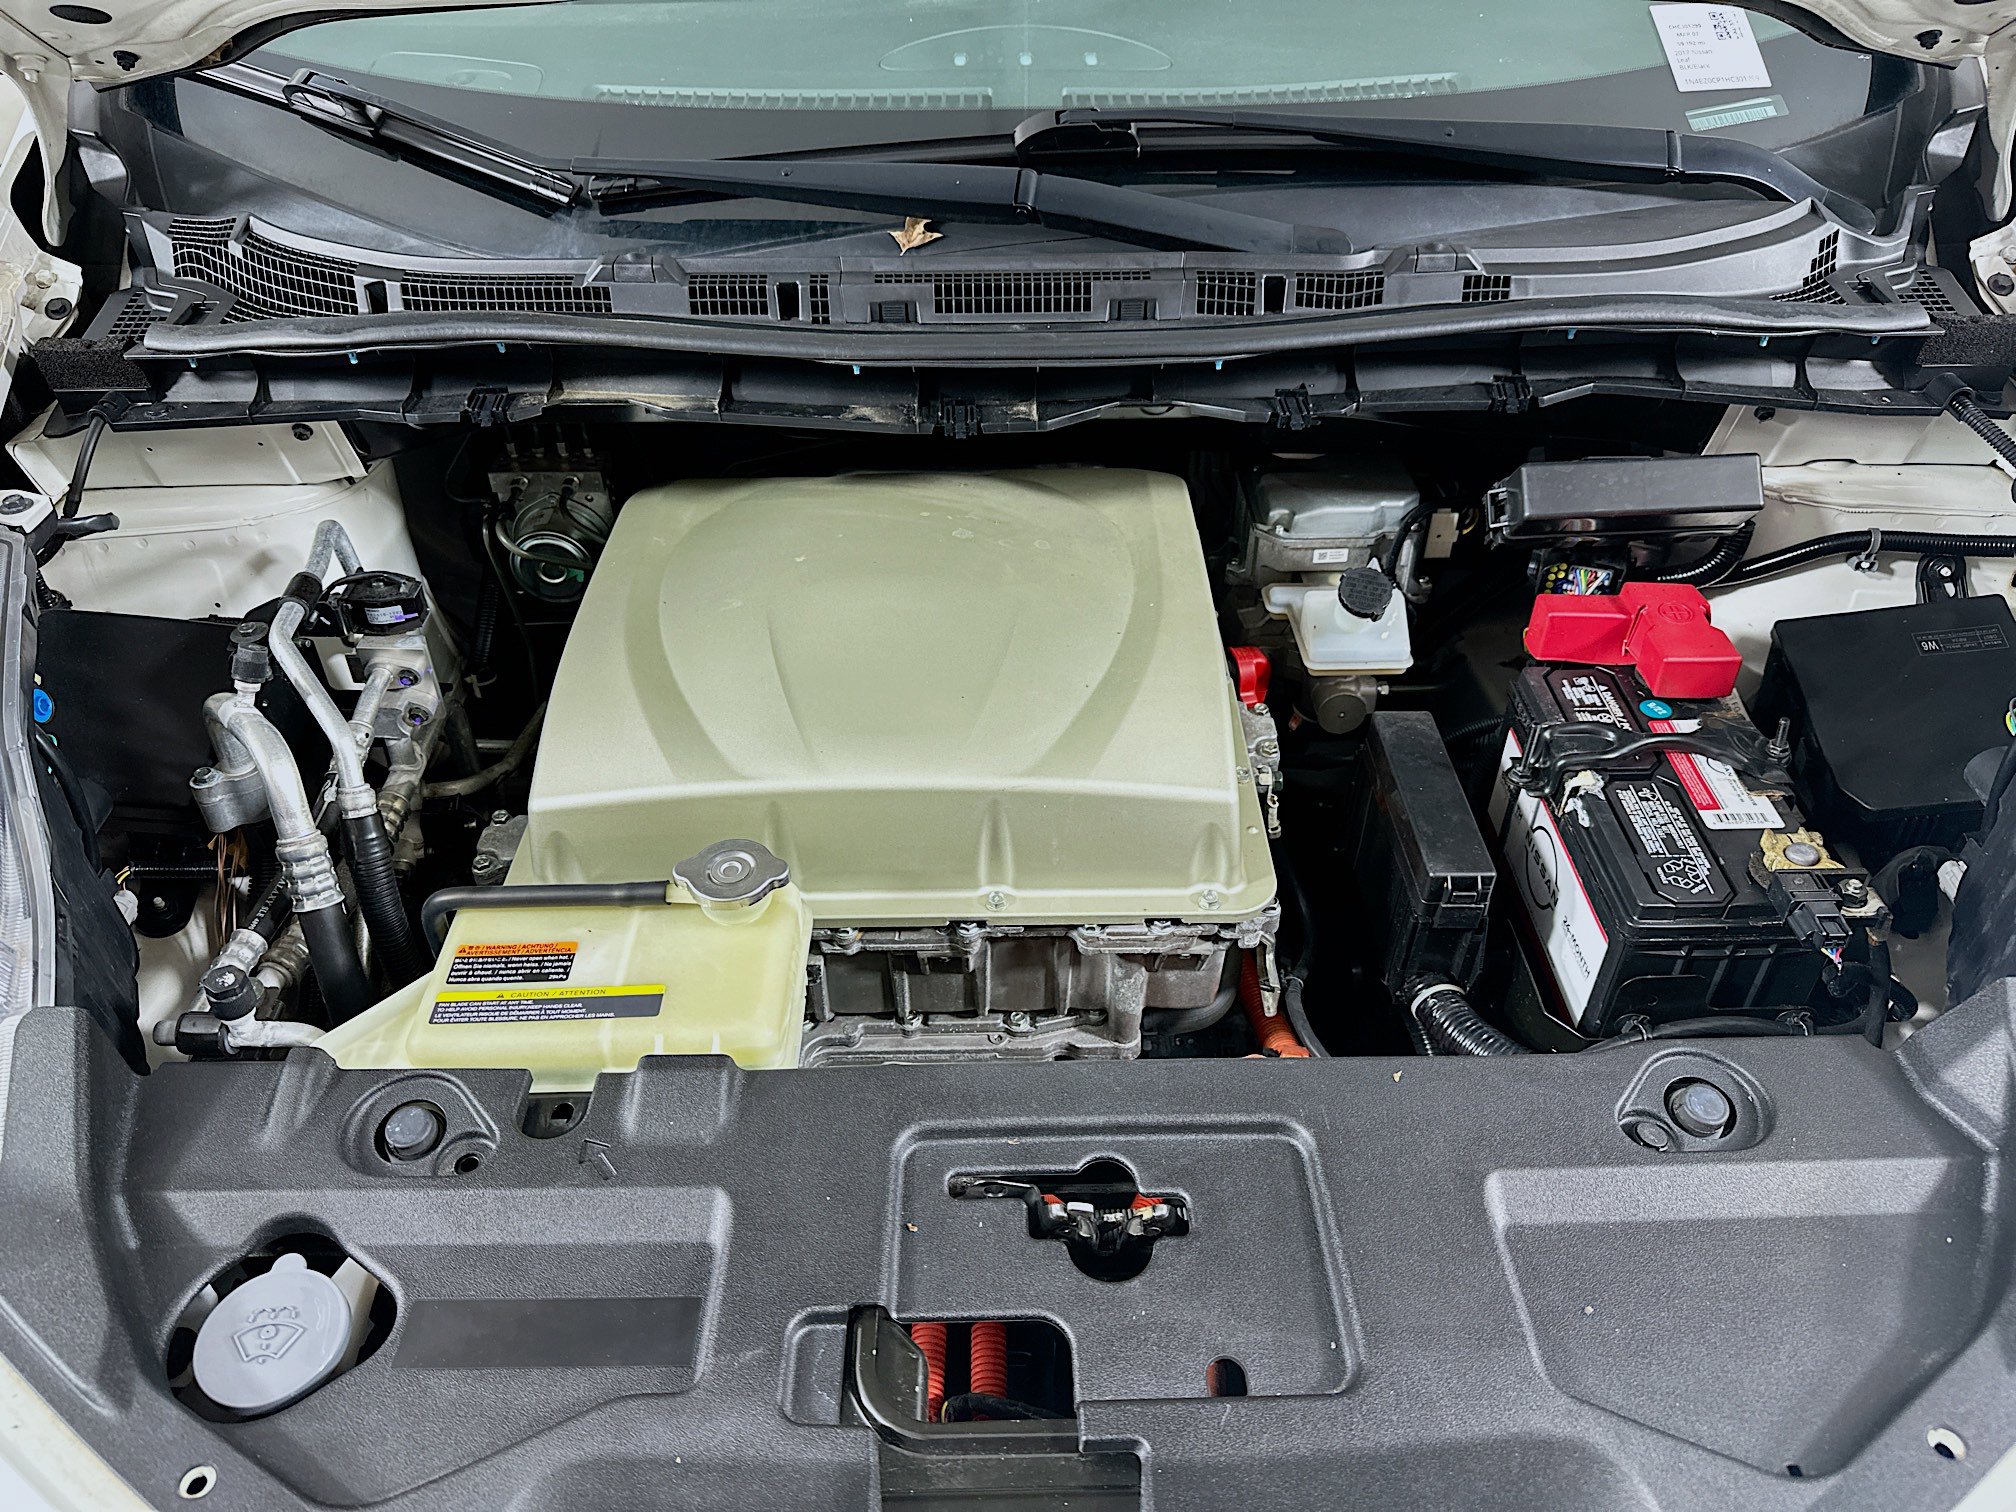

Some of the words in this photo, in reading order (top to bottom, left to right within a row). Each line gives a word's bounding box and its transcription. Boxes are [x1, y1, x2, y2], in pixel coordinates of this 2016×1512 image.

[1921, 640, 1940, 651] W6
[1525, 829, 1559, 908] NISSAN
[256, 906, 270, 918] SLE
